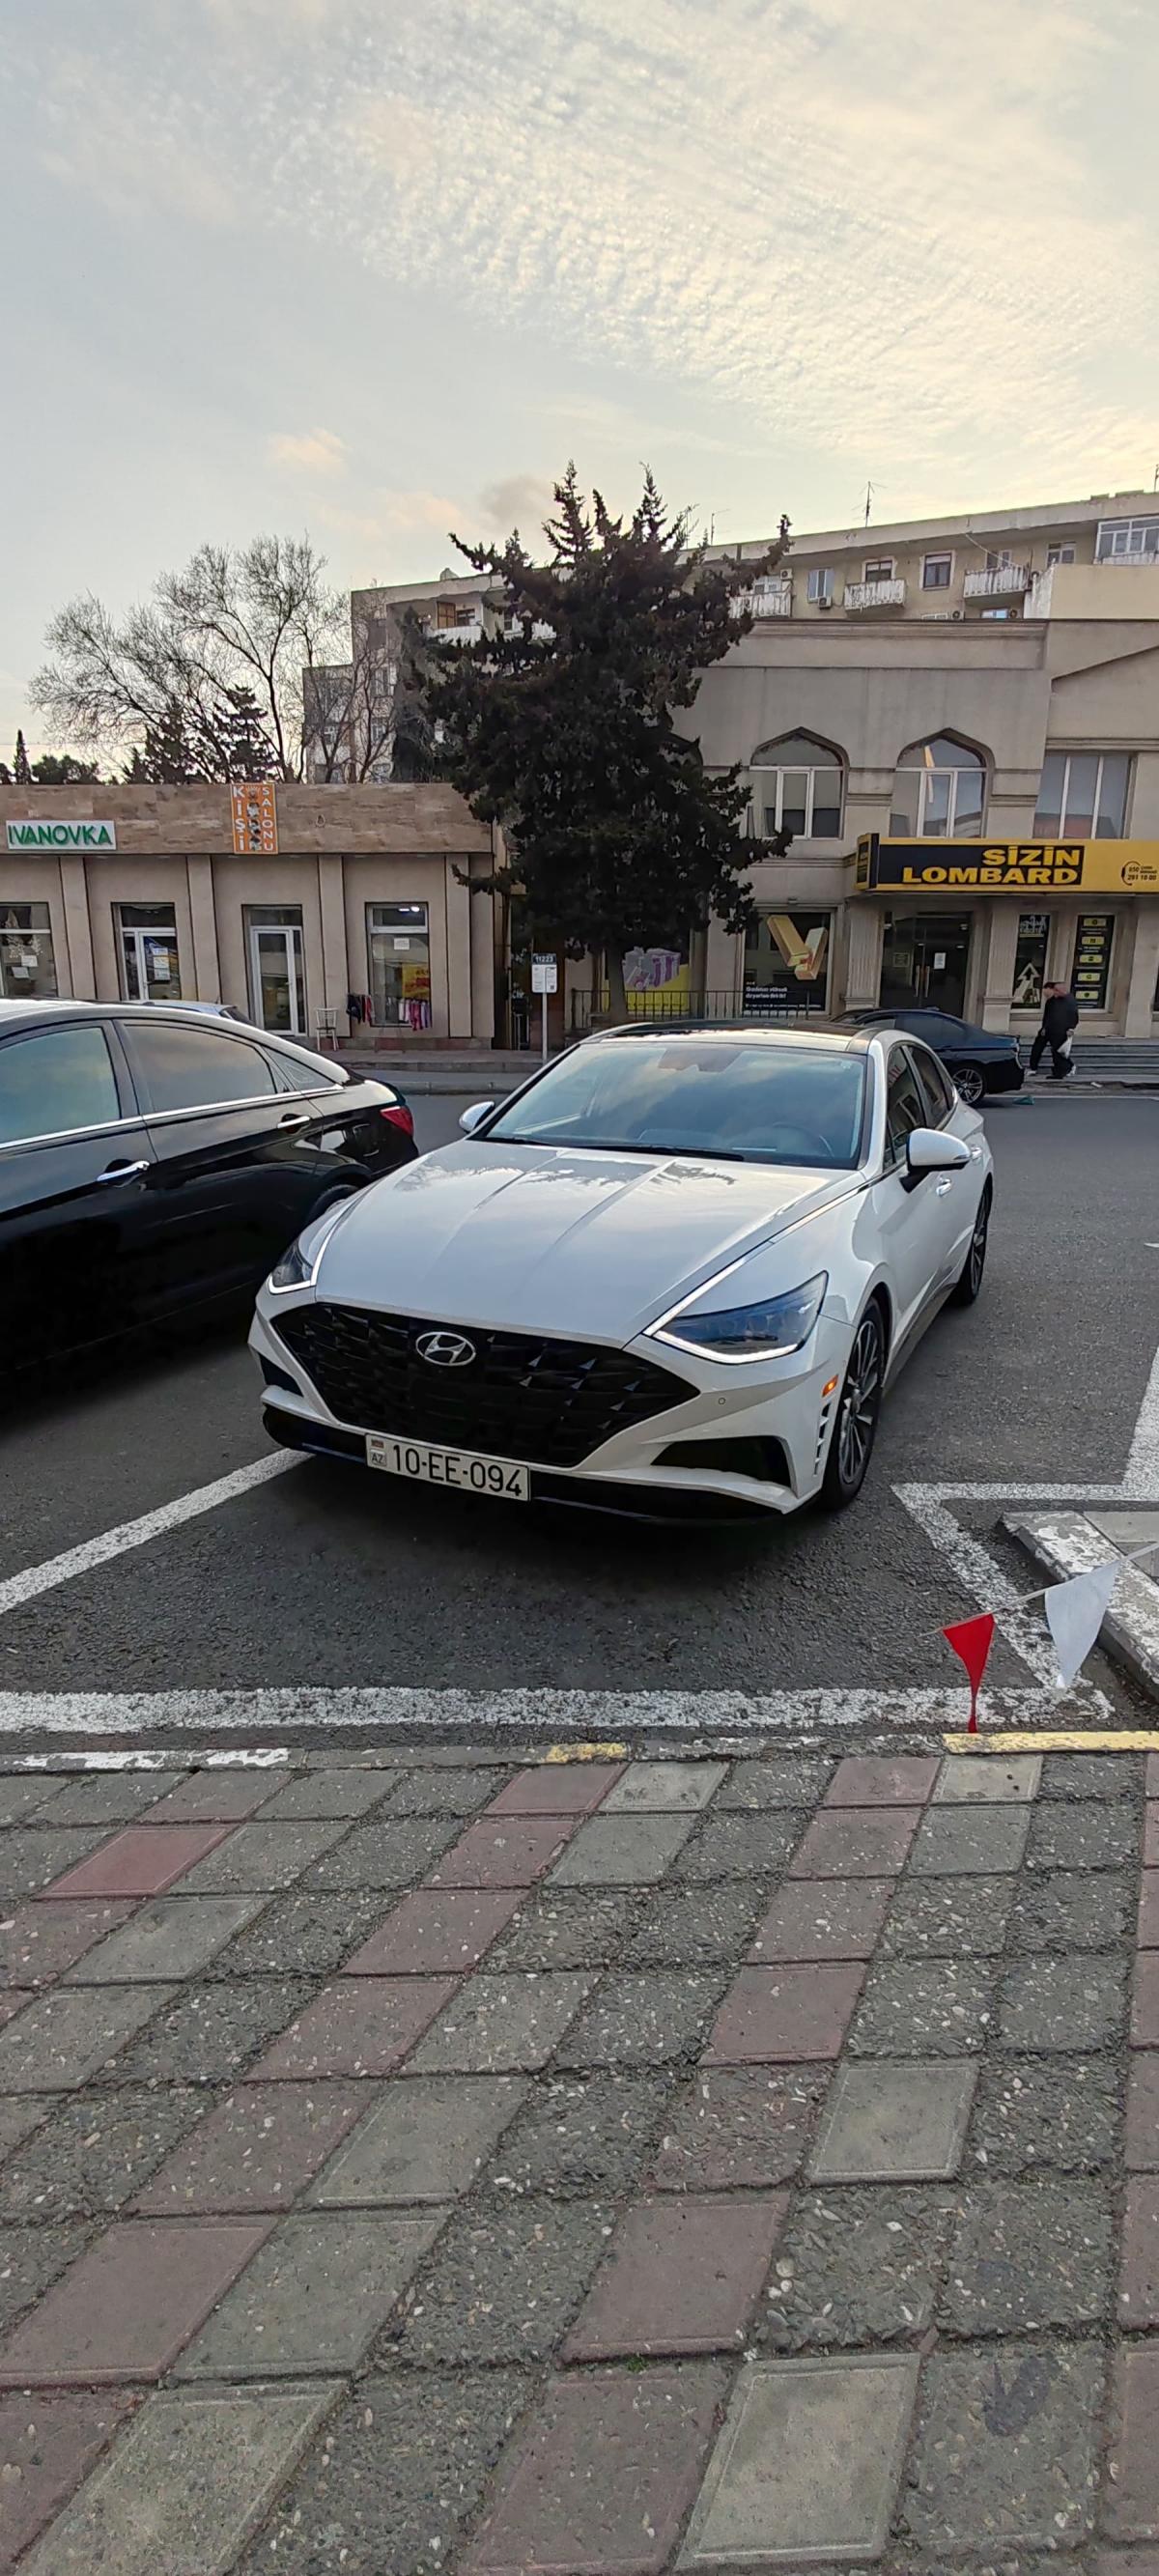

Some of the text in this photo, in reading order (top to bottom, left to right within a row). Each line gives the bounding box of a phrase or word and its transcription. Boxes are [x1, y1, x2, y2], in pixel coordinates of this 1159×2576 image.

[233, 785, 245, 851] KİŞİ
[262, 786, 274, 851] SALONU
[8, 825, 113, 845] IVANOVKA
[982, 846, 1081, 866] SİZİN
[902, 866, 1078, 884] LOMBARD
[371, 1453, 384, 1464] AZ
[393, 1445, 523, 1496] 10-EE-094
